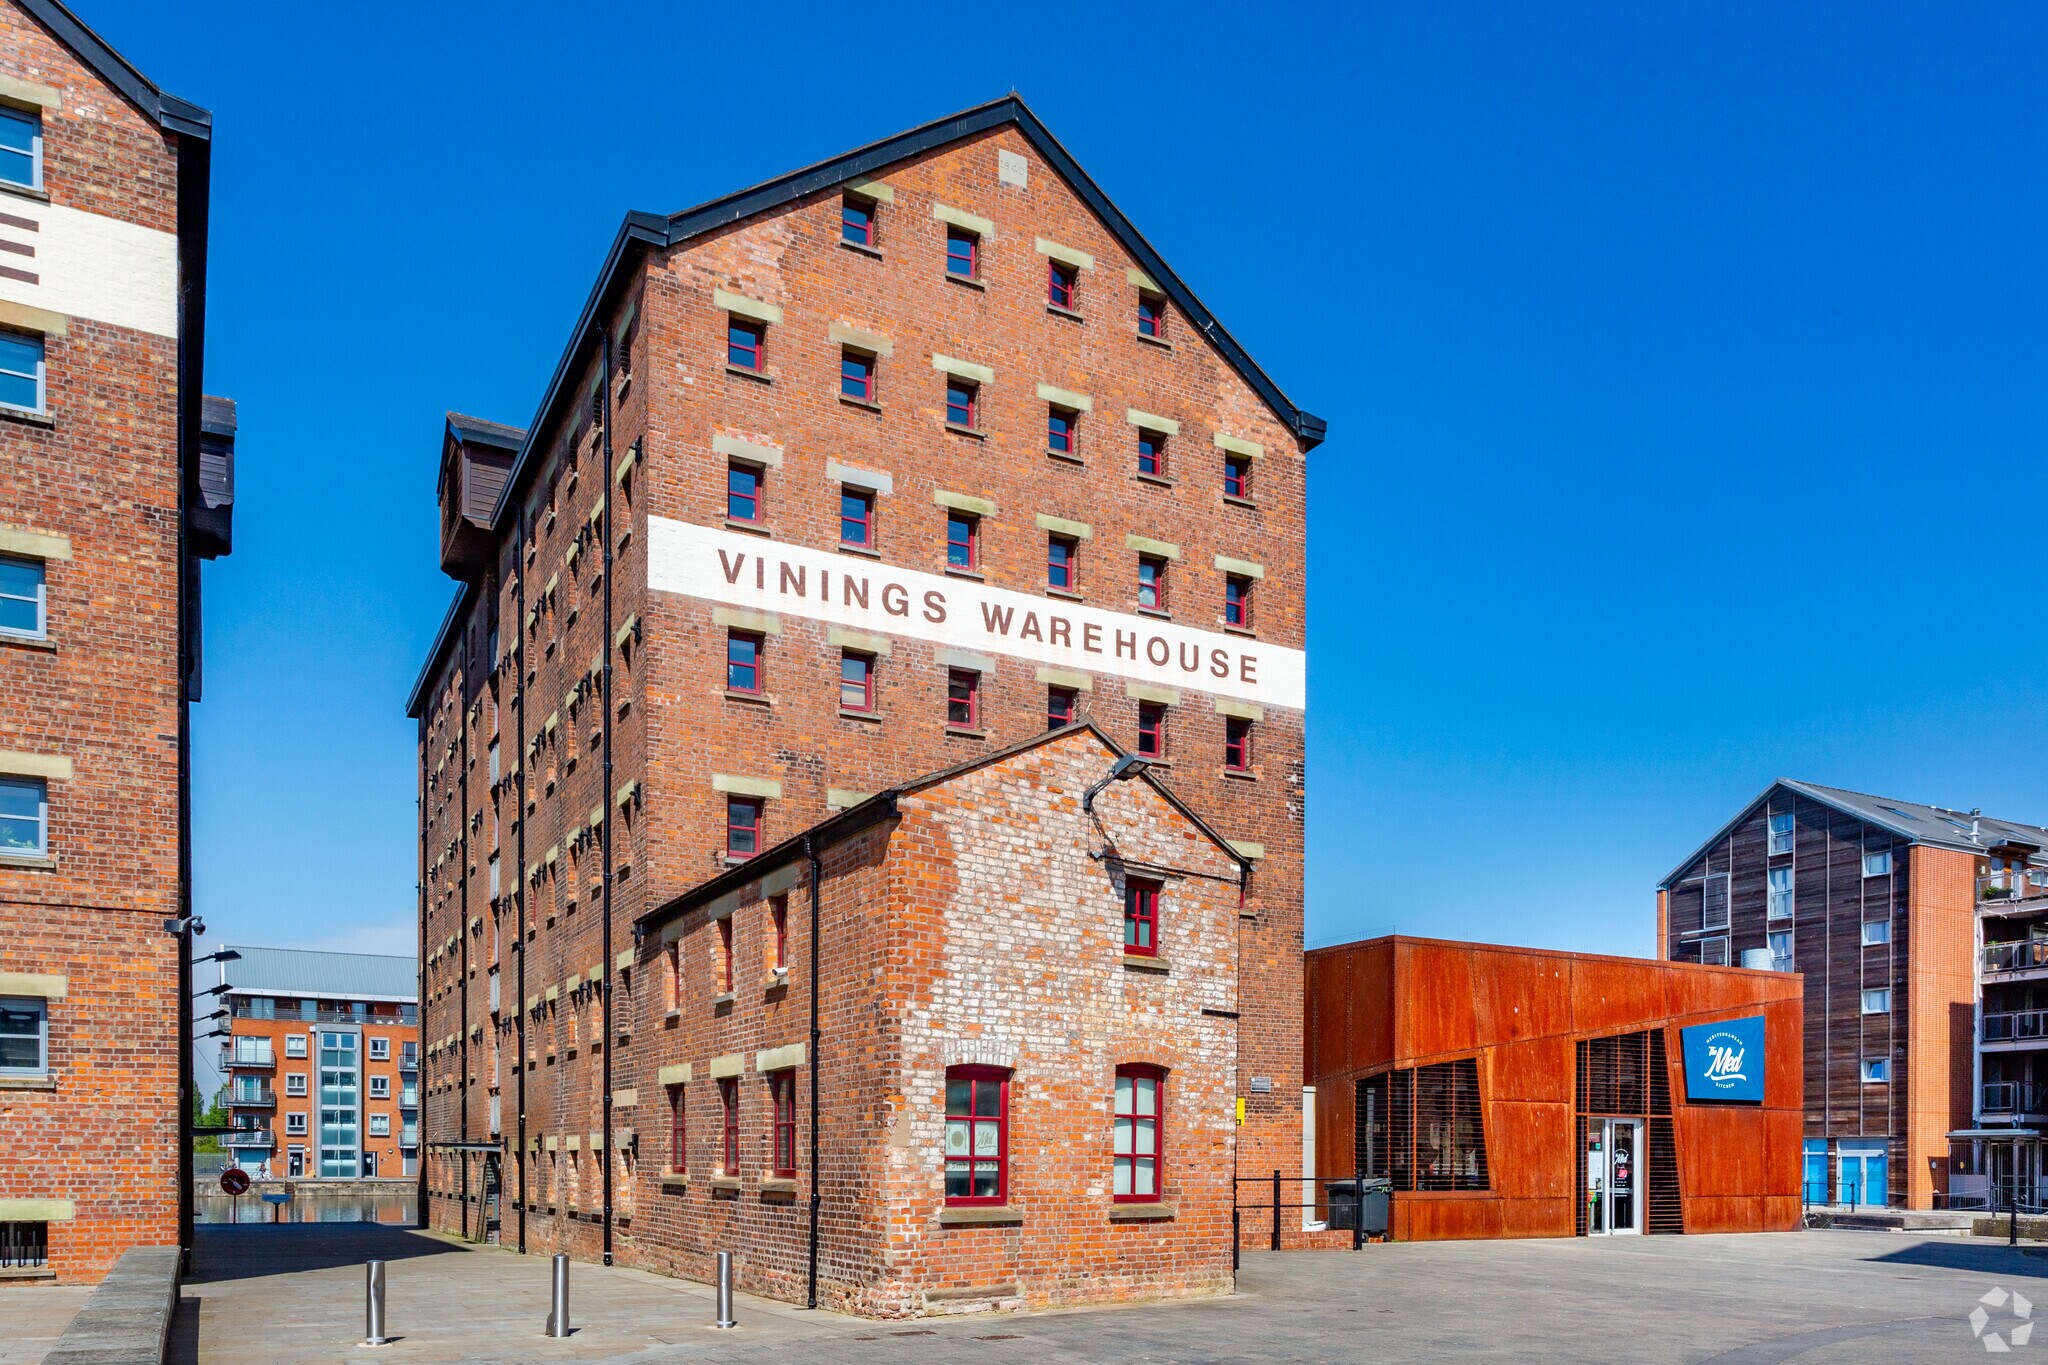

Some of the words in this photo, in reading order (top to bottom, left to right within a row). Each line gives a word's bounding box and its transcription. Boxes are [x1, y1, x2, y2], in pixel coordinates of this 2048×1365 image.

[717, 548, 948, 624] VININGS
[980, 601, 1258, 685] WAREHOUSE
[1703, 1046, 1745, 1078] Med
